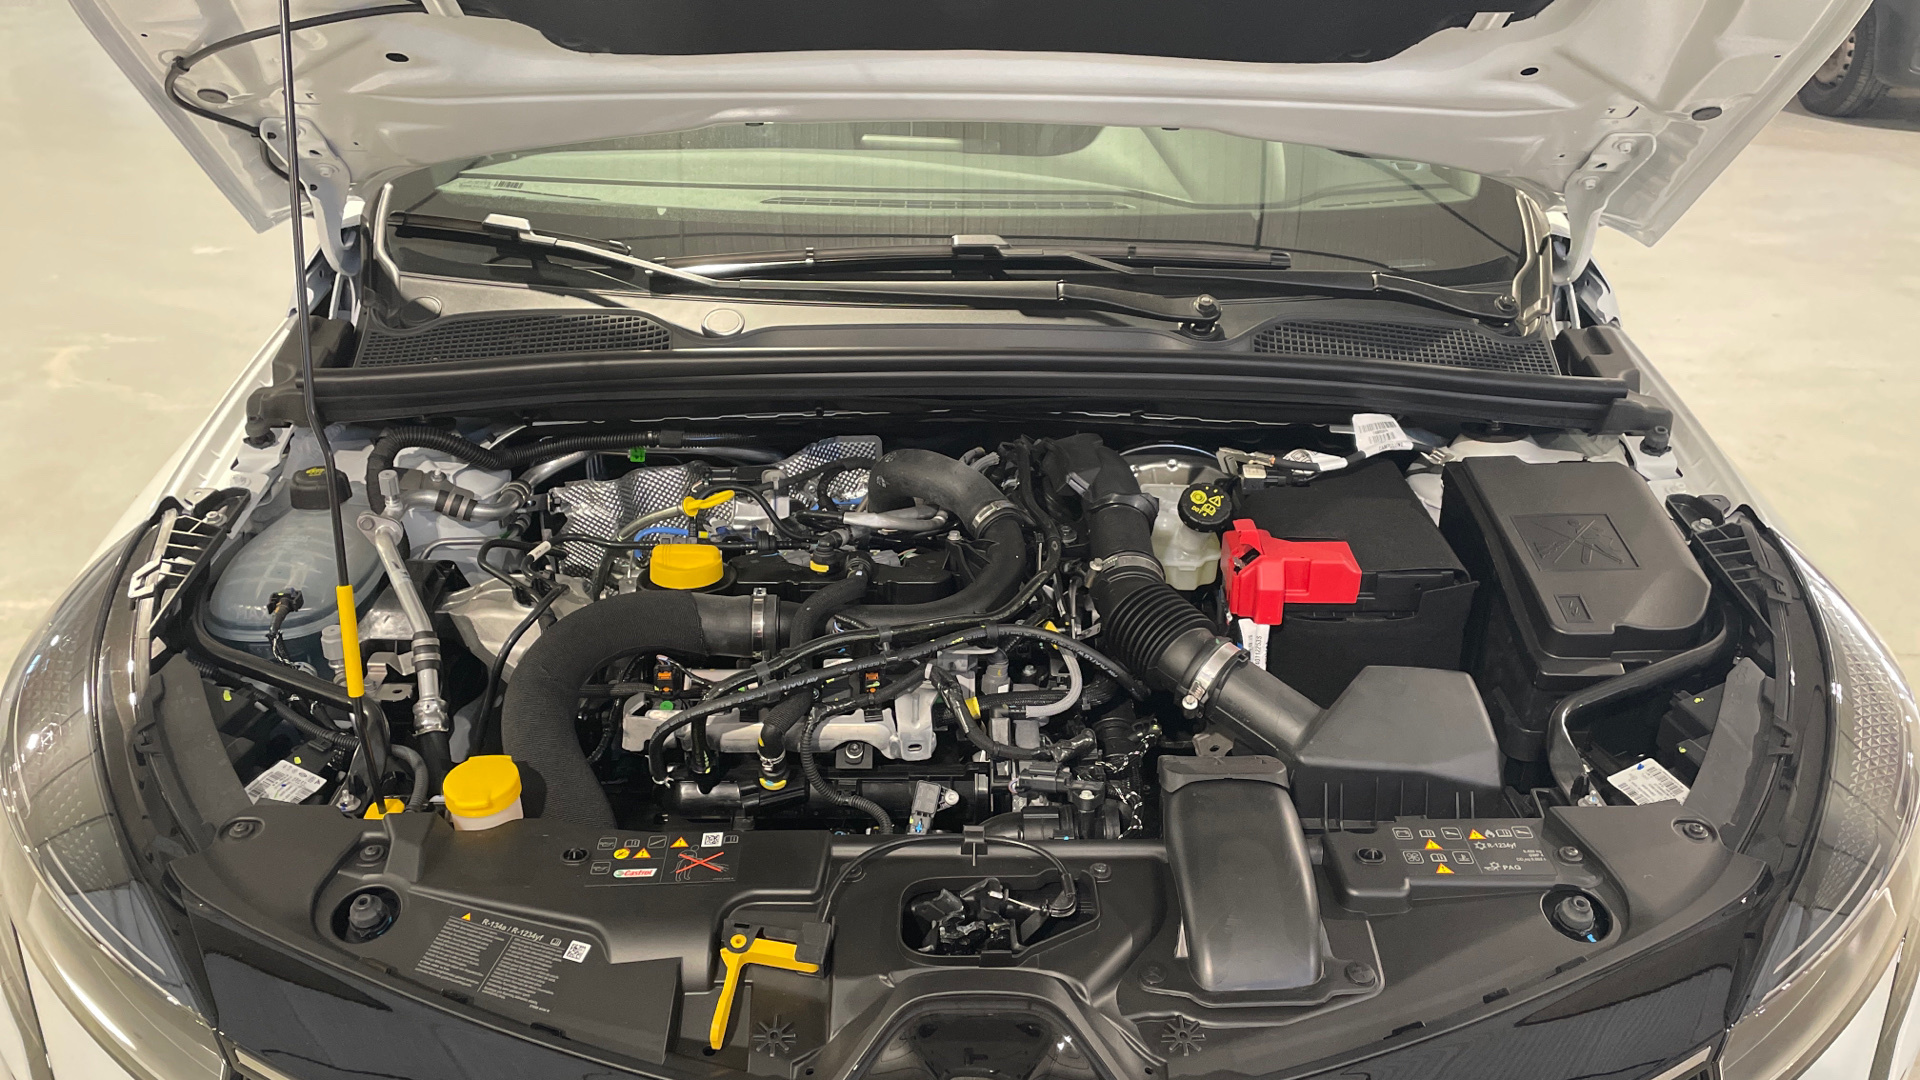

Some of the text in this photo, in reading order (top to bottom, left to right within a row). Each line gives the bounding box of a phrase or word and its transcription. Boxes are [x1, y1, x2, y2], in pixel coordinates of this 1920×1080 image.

[624, 869, 653, 877] Castrol
[481, 918, 507, 931] R-134a
[511, 926, 545, 942] R-1234yf
